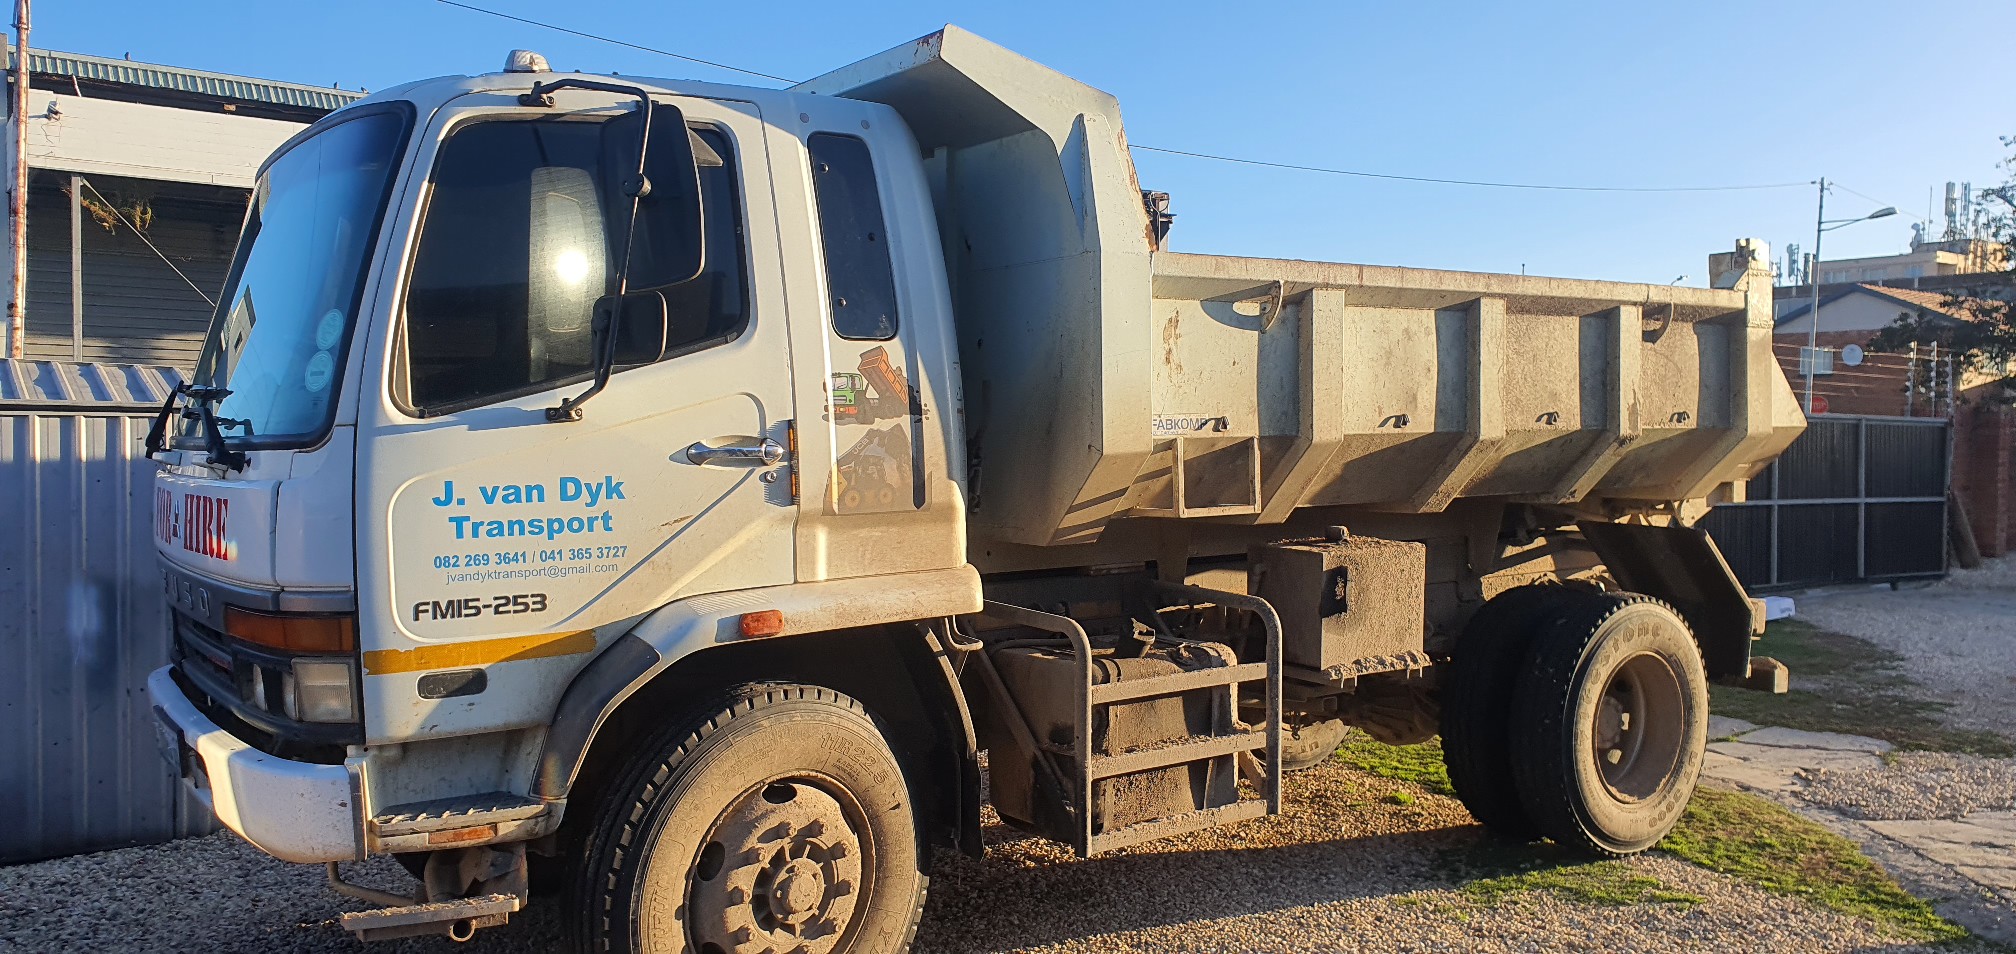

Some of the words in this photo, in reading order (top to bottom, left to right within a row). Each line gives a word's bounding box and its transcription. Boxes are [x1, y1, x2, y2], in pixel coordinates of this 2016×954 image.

[853, 437, 870, 455] JCB
[432, 480, 466, 507] J.
[479, 483, 545, 505] van
[559, 475, 626, 508] Dyk
[183, 493, 229, 561] HIRE
[448, 510, 614, 541] Transport
[433, 554, 461, 569] 082
[464, 553, 490, 567] 269
[494, 551, 527, 566] 3641
[539, 548, 564, 563] 041
[568, 547, 593, 561] 365
[596, 545, 628, 559] 3727
[445, 562, 619, 585] jvandyktransport@gmail.com
